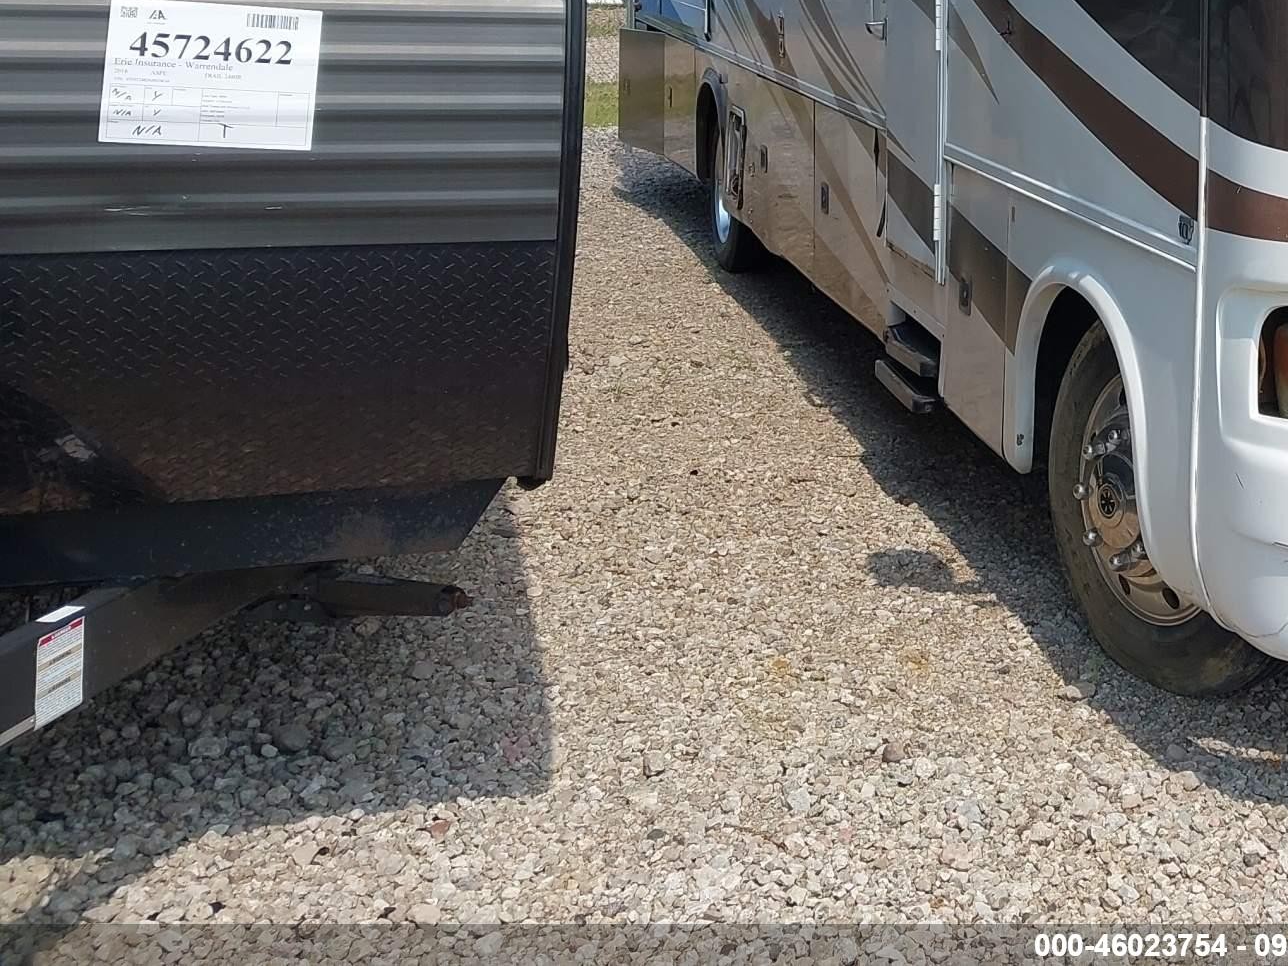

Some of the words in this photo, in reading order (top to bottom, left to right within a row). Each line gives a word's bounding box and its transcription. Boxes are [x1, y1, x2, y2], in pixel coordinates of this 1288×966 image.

[129, 32, 292, 65] 45724622
[114, 57, 133, 66] Erie
[135, 58, 177, 68] Insurance
[185, 61, 234, 72] Warrendale
[132, 125, 162, 136] N/A
